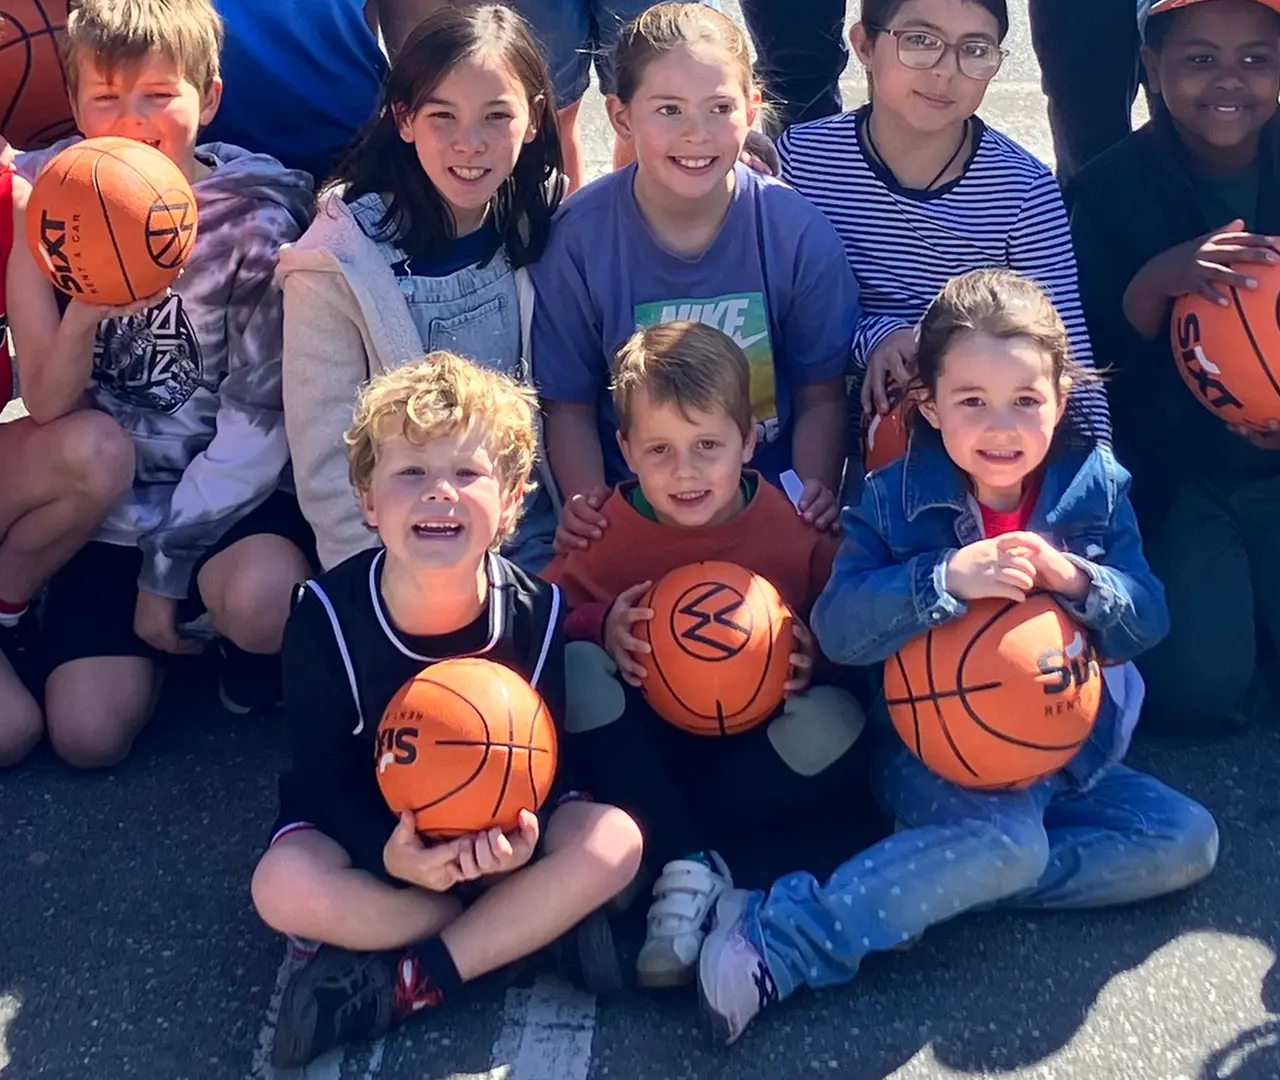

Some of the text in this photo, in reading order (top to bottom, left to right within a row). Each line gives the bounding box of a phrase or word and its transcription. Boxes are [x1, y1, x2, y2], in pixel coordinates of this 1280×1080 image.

[39, 208, 85, 294] SIXT
[72, 214, 82, 243] CAR
[1177, 311, 1245, 410] SIXT
